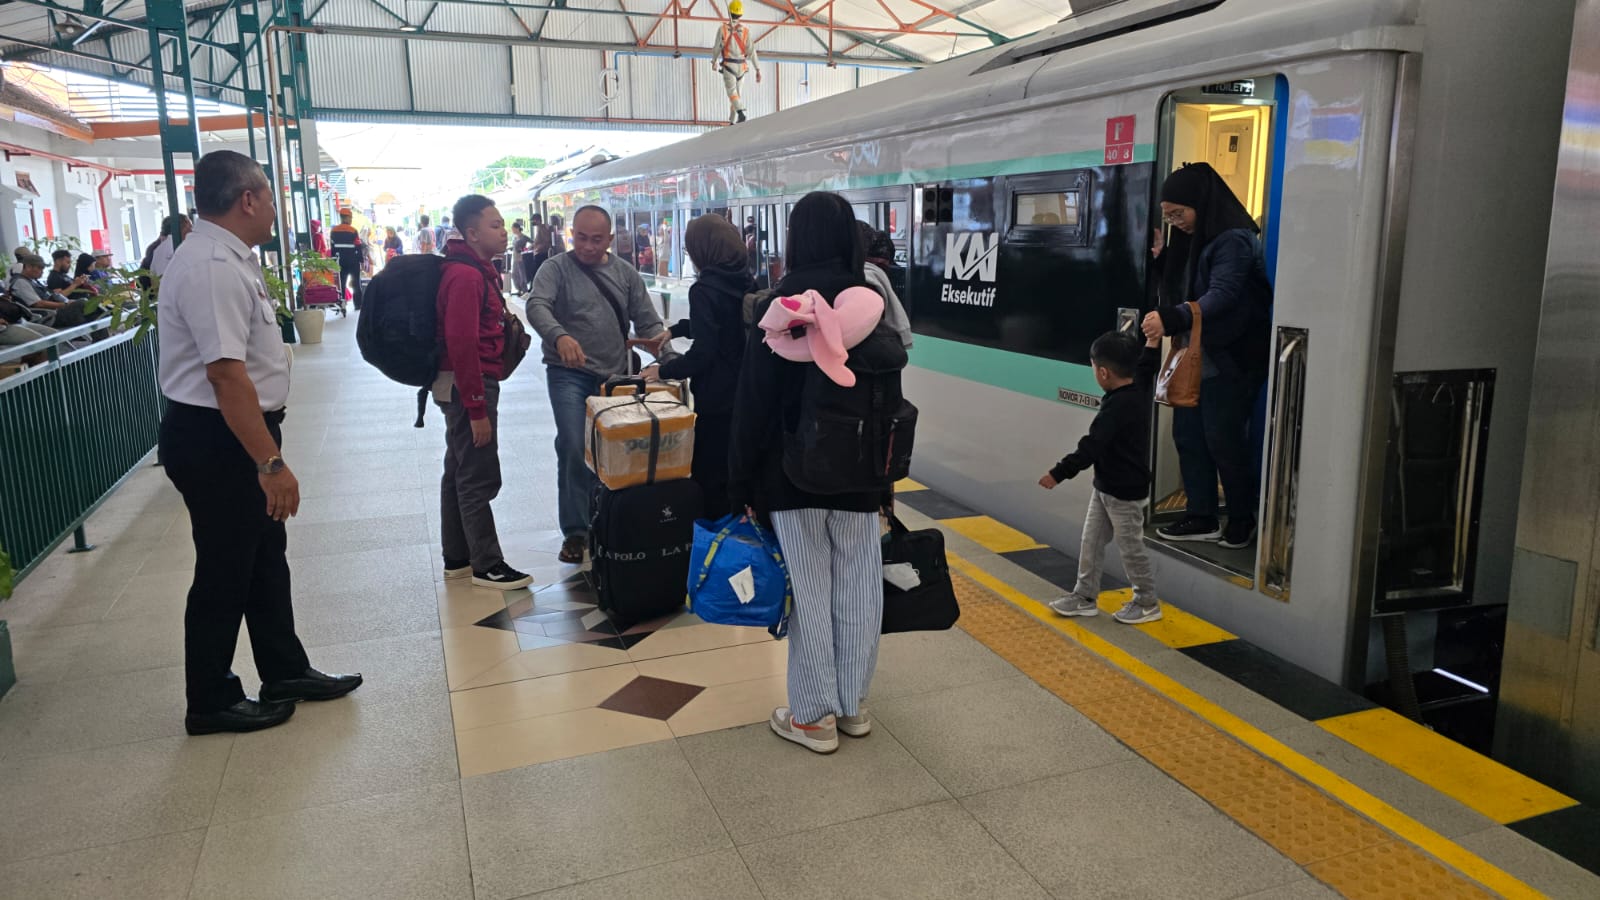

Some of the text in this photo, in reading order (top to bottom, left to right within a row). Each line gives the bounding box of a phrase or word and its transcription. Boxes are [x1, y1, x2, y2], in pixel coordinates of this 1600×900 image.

[944, 232, 999, 282] KAI
[941, 284, 997, 307] Eksekutif
[614, 551, 647, 561] POLO
[662, 546, 681, 557] LA
